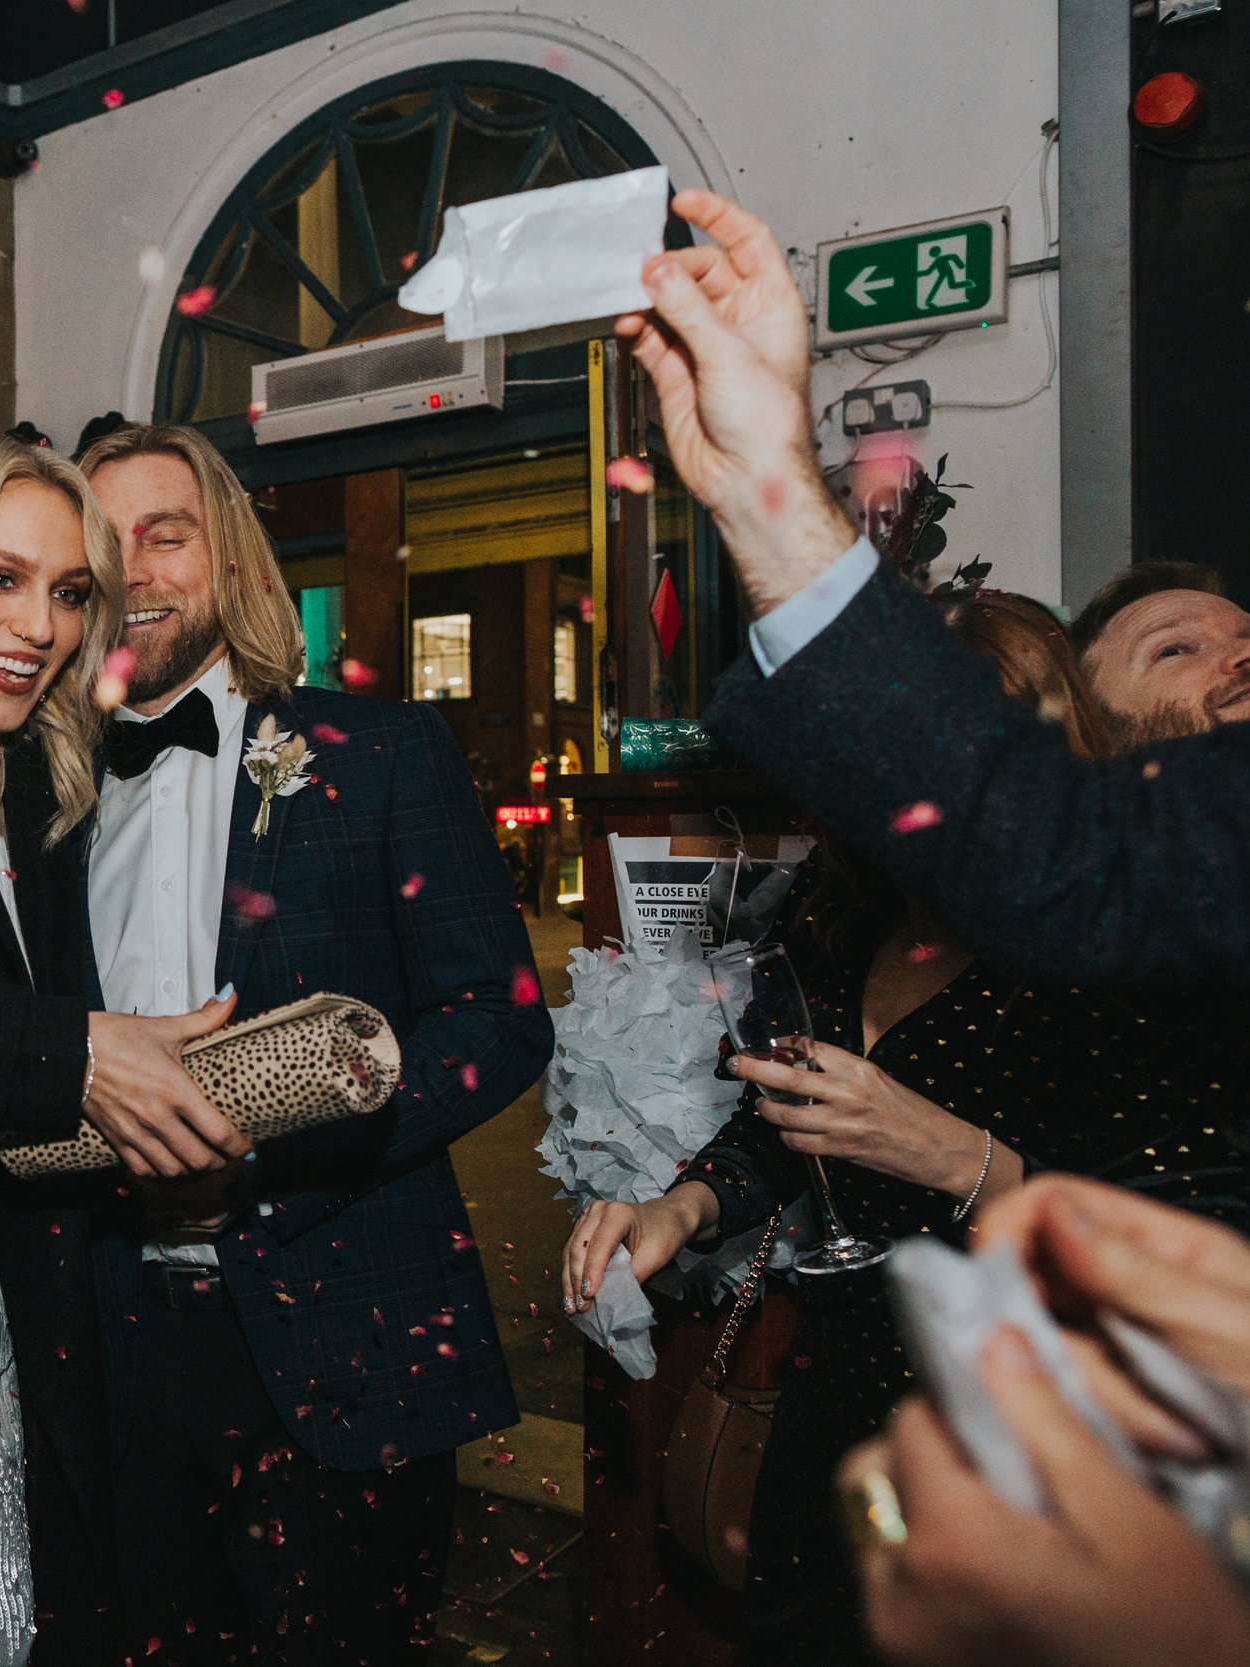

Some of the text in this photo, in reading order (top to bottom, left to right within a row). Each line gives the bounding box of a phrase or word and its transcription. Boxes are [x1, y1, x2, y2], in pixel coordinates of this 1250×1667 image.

[636, 887, 708, 898] A CLOSE EYE
[661, 908, 704, 919] DRINKS
